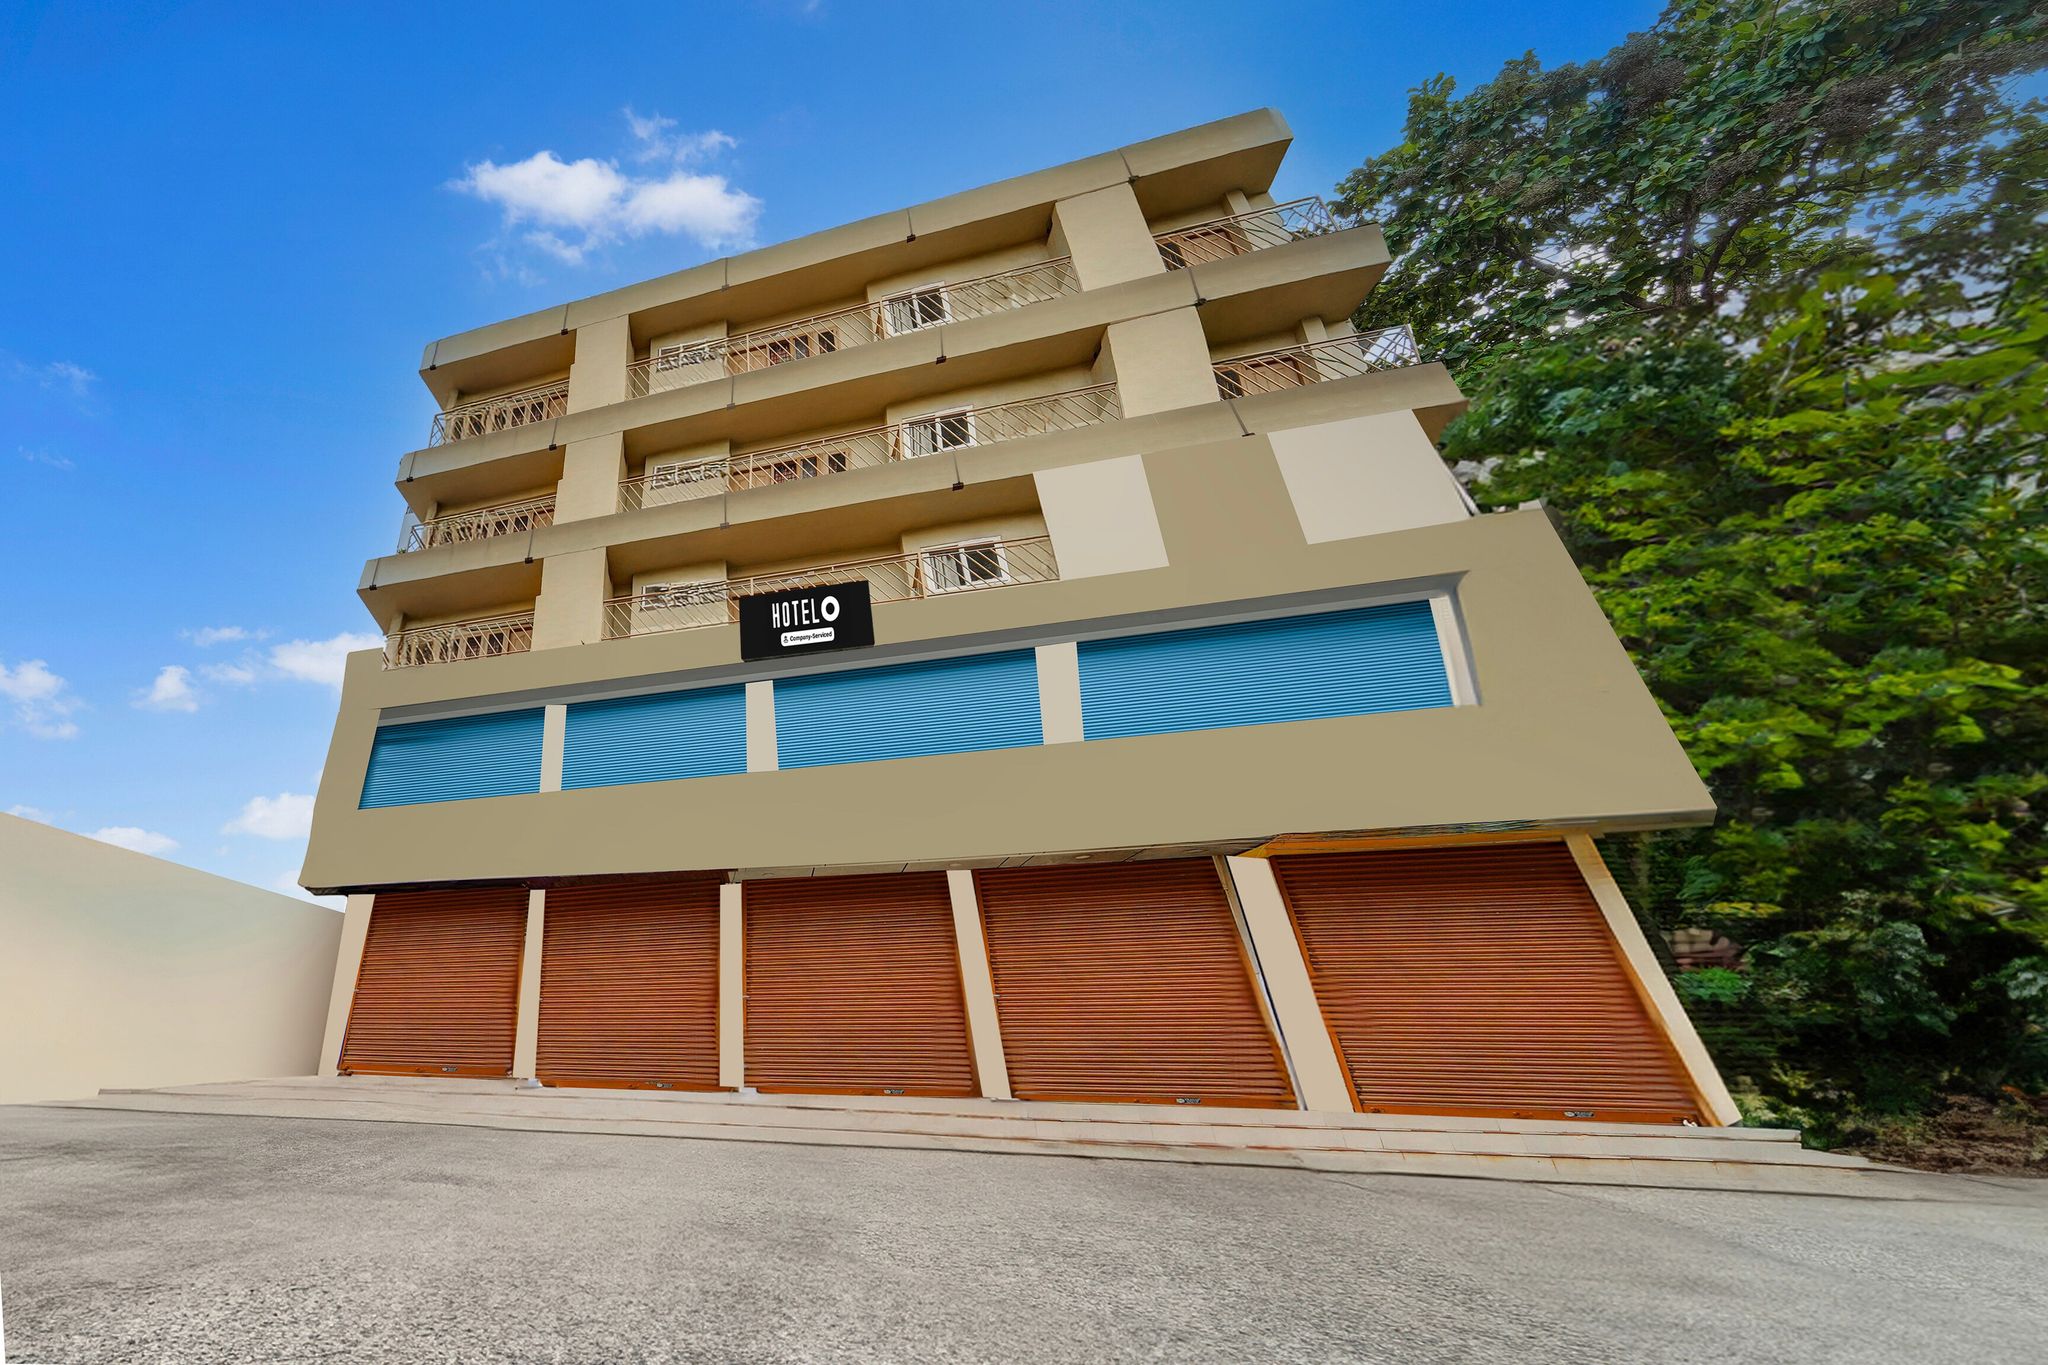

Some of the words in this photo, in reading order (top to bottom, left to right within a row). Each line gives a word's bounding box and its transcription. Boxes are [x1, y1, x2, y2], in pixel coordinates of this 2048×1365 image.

[771, 597, 820, 629] HOTEL
[820, 595, 841, 622] O
[789, 631, 833, 643] Company-Serviced
